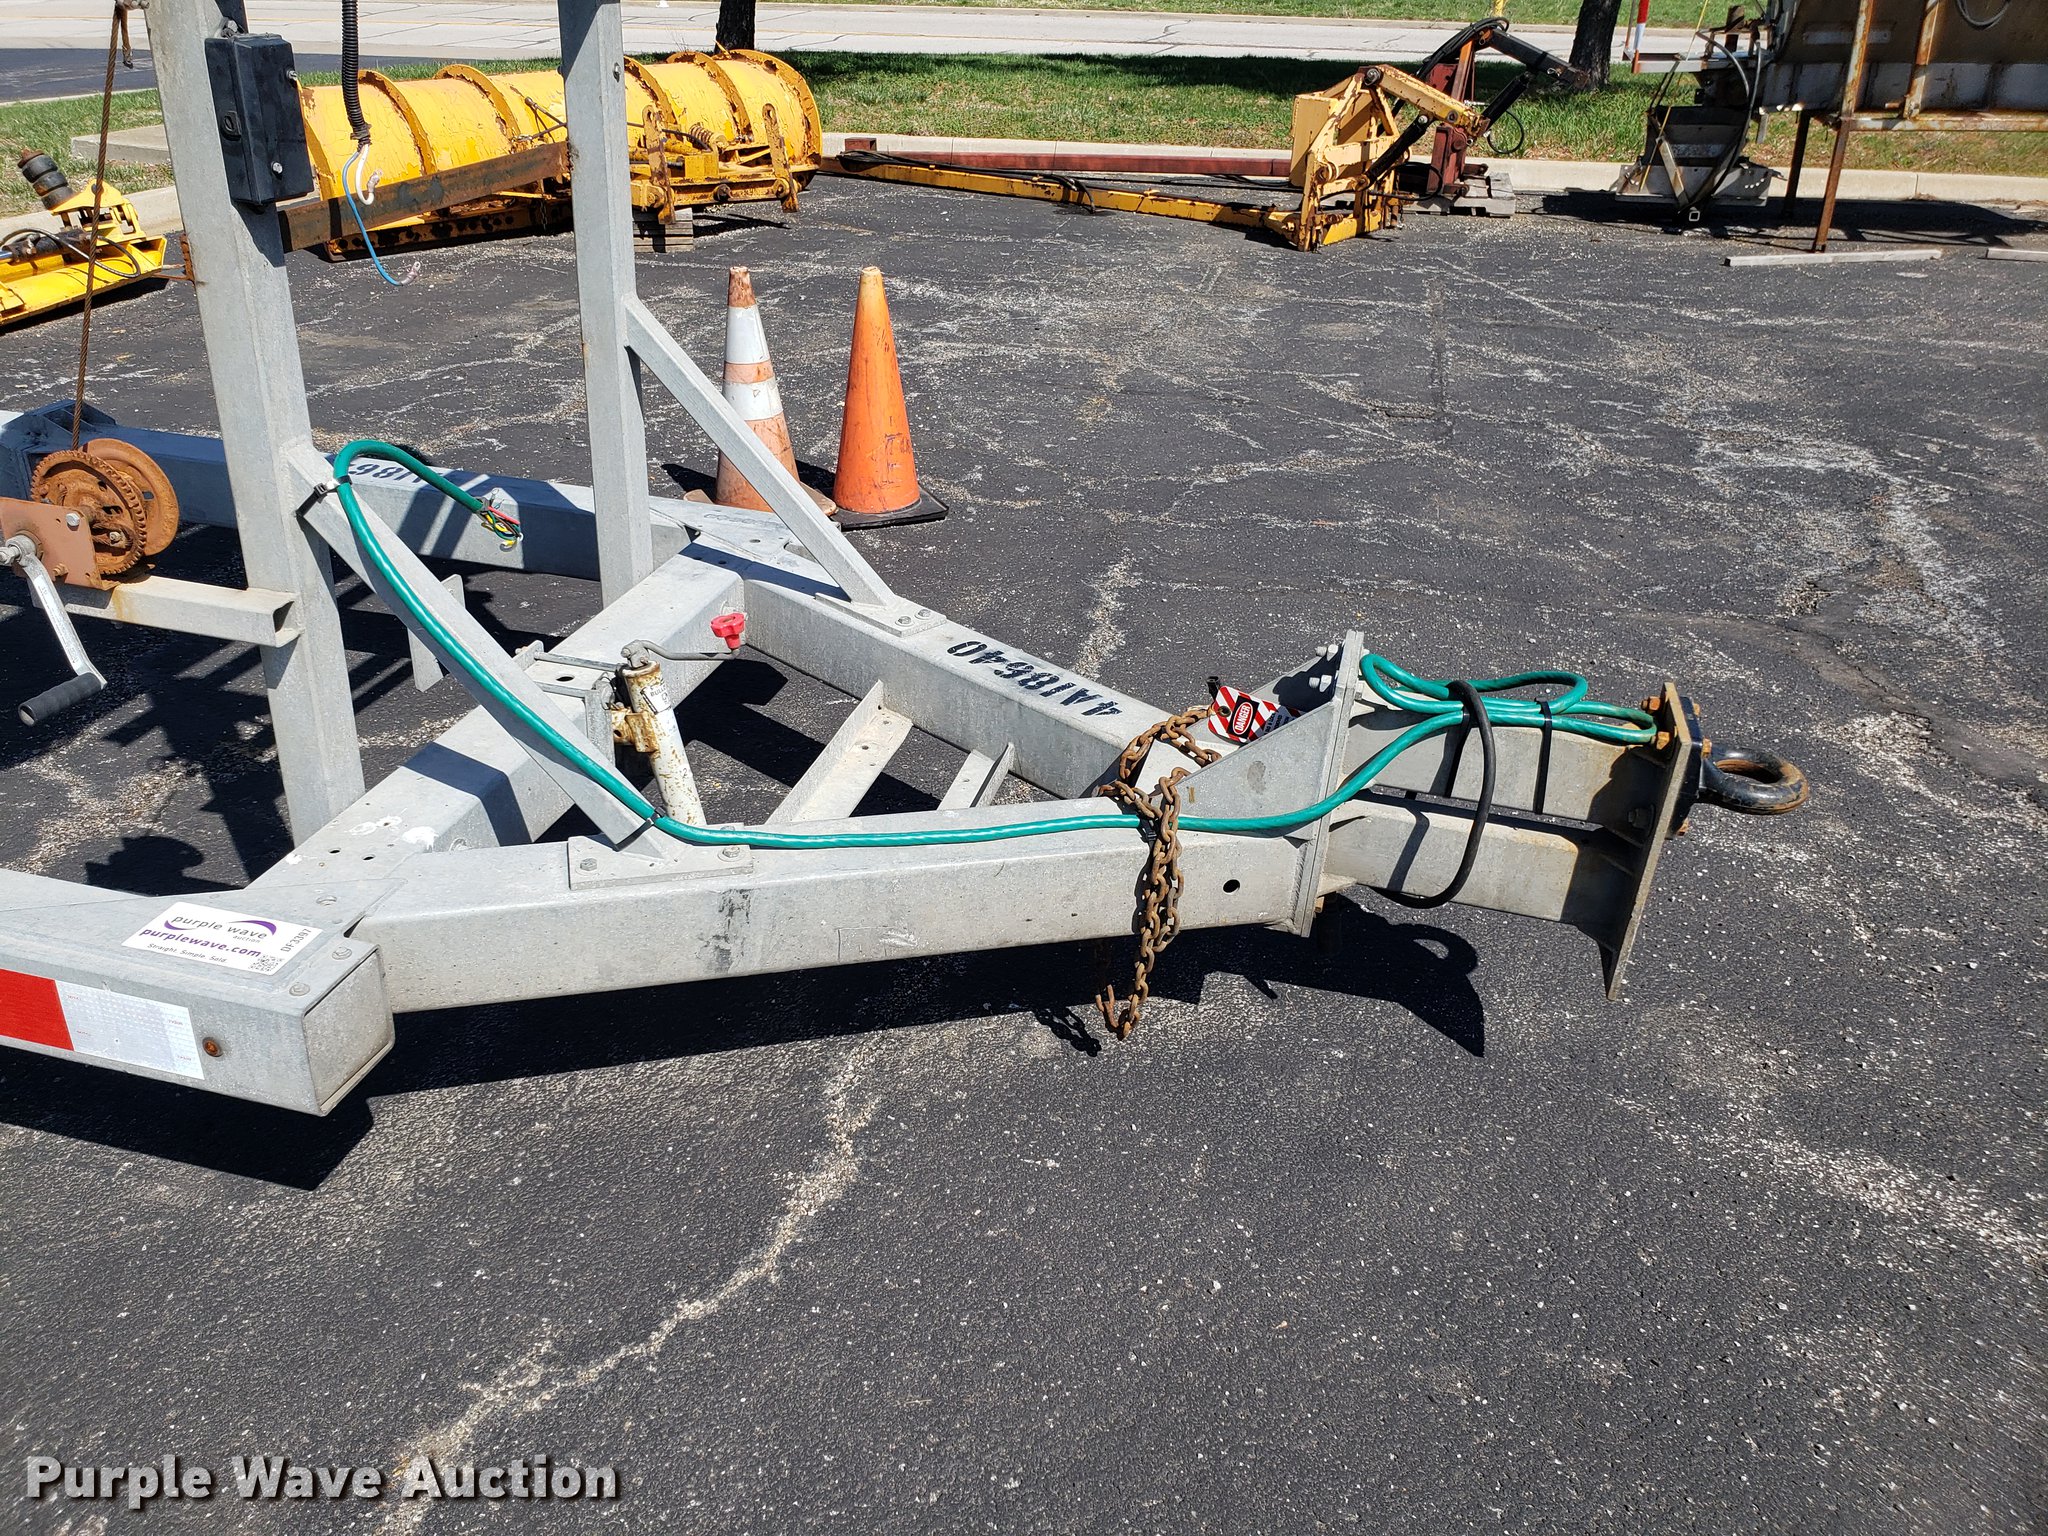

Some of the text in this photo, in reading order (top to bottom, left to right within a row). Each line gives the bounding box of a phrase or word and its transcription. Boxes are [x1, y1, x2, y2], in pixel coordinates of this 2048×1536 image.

[1234, 705, 1251, 731] DANGER
[171, 916, 267, 939] purple wave
[233, 935, 260, 943] auction
[139, 929, 261, 957] purplewave.com
